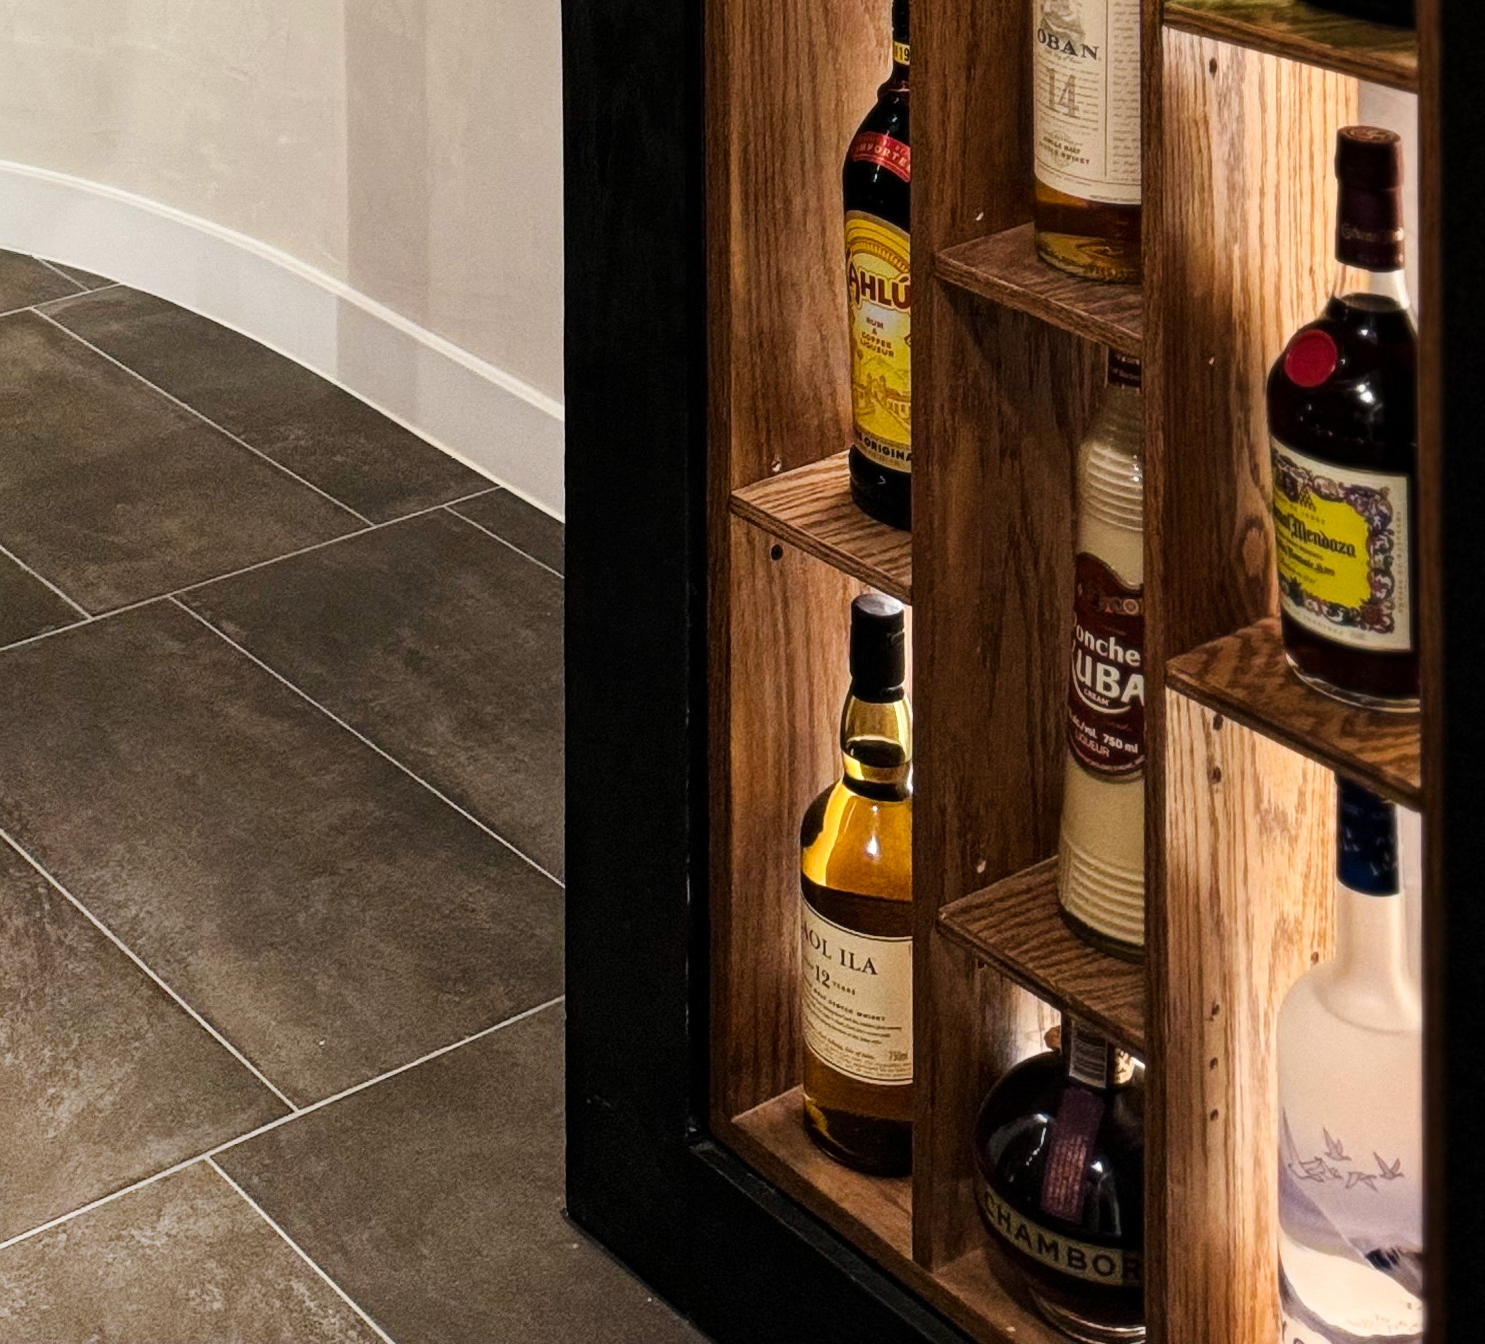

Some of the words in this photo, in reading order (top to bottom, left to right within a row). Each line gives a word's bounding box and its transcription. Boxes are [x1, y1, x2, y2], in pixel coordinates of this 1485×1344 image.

[1036, 27, 1100, 61] OBAN
[1047, 66, 1080, 117] 14
[855, 142, 911, 172] IMPORTE
[865, 316, 884, 330] RUM
[859, 338, 895, 358] LIQUEUR
[861, 331, 892, 349] COFFEE
[1290, 518, 1357, 559] Mendoza
[1083, 686, 1111, 708] CREAM
[1102, 731, 1124, 750] 750
[1123, 738, 1140, 755] ml
[839, 947, 879, 977] ILA
[815, 964, 832, 991] 12
[831, 980, 857, 997] YEARS
[827, 998, 854, 1015] SCOTCH
[856, 1010, 887, 1022] WHISKY
